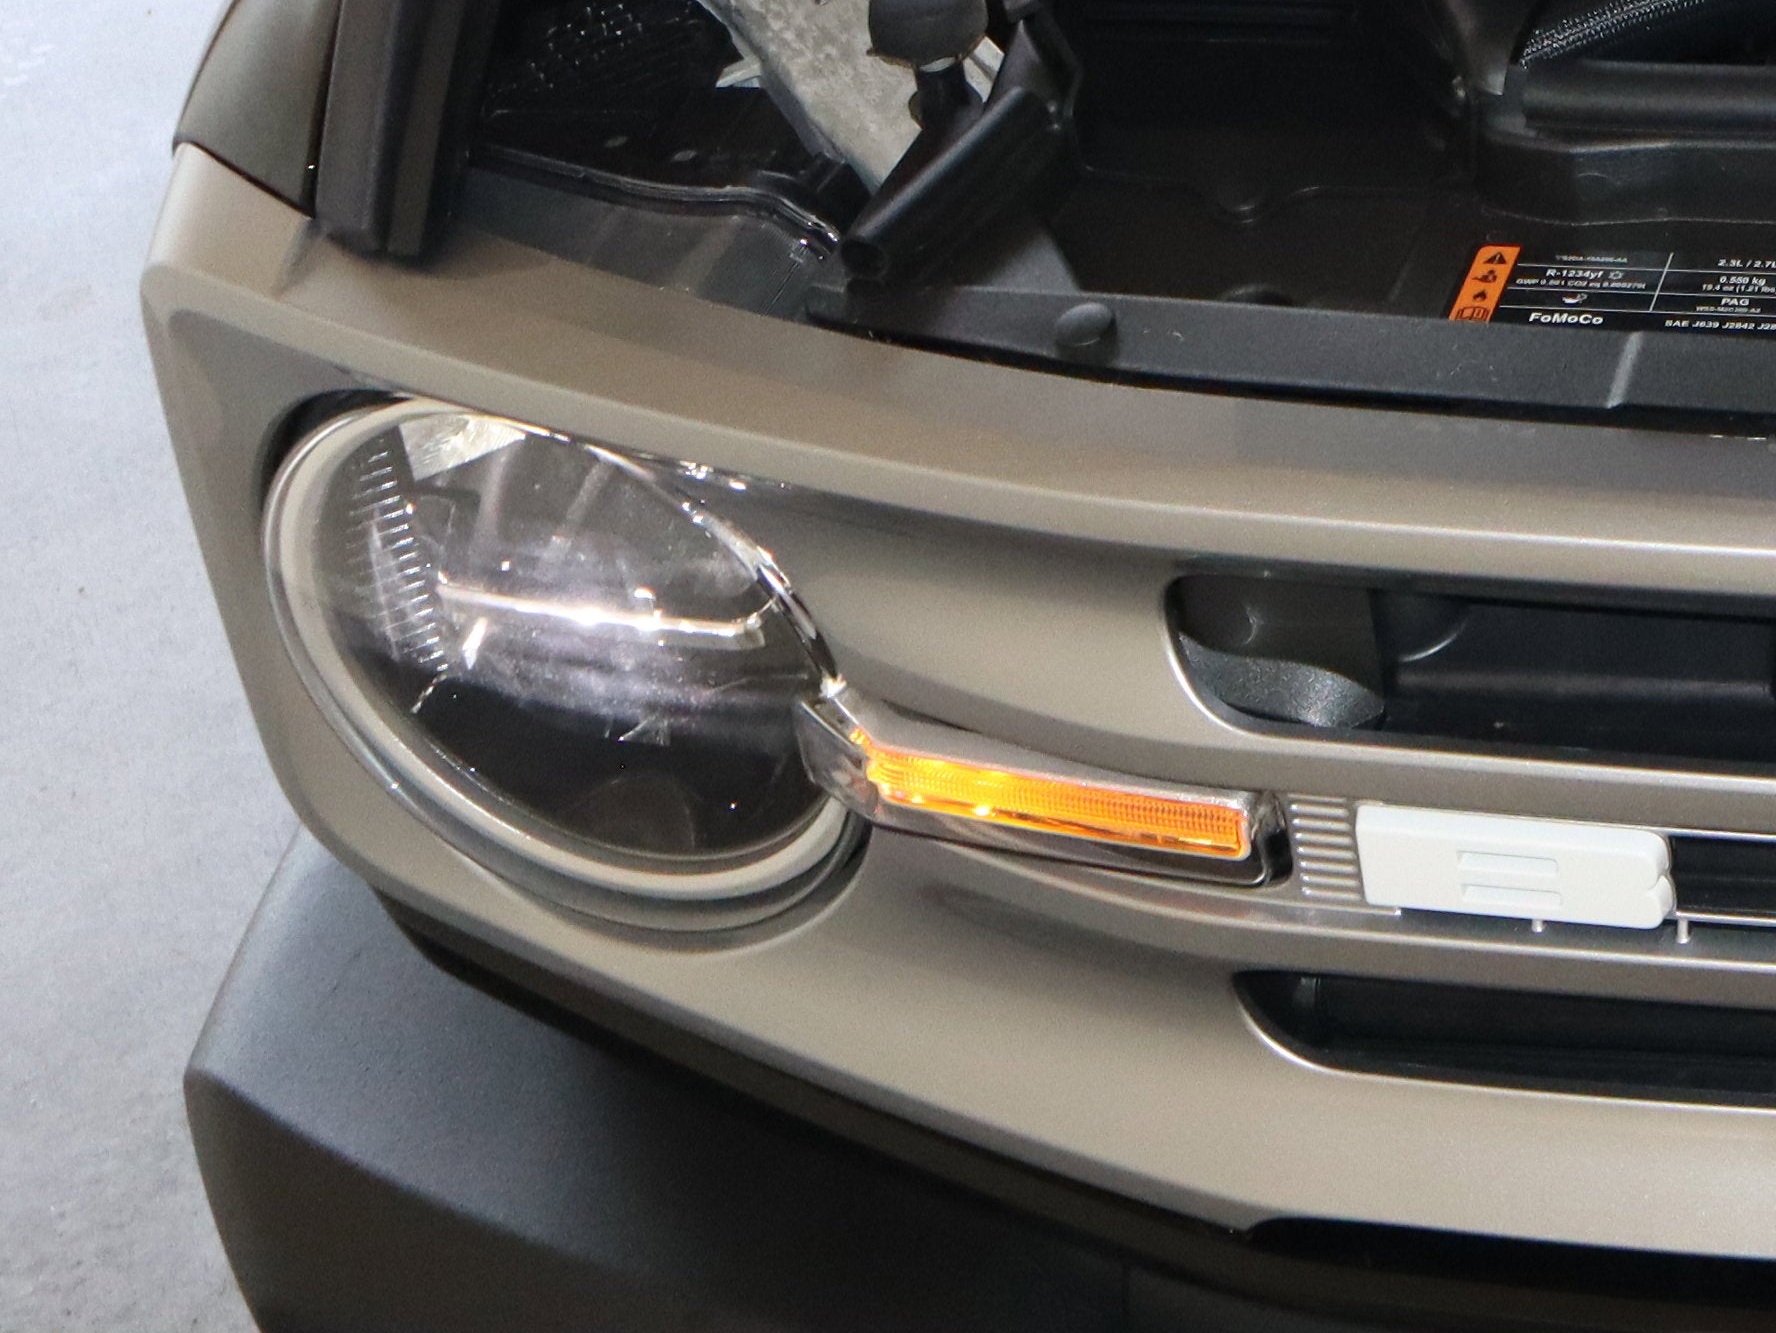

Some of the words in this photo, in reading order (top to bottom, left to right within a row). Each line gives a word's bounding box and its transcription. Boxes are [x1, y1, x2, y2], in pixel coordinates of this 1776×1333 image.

[1545, 268, 1604, 280] R-1234yf
[1751, 276, 1767, 286] kg
[1720, 297, 1750, 306] PAG
[1528, 312, 1604, 325] FoMoCo
[1664, 319, 1690, 328] SAE
